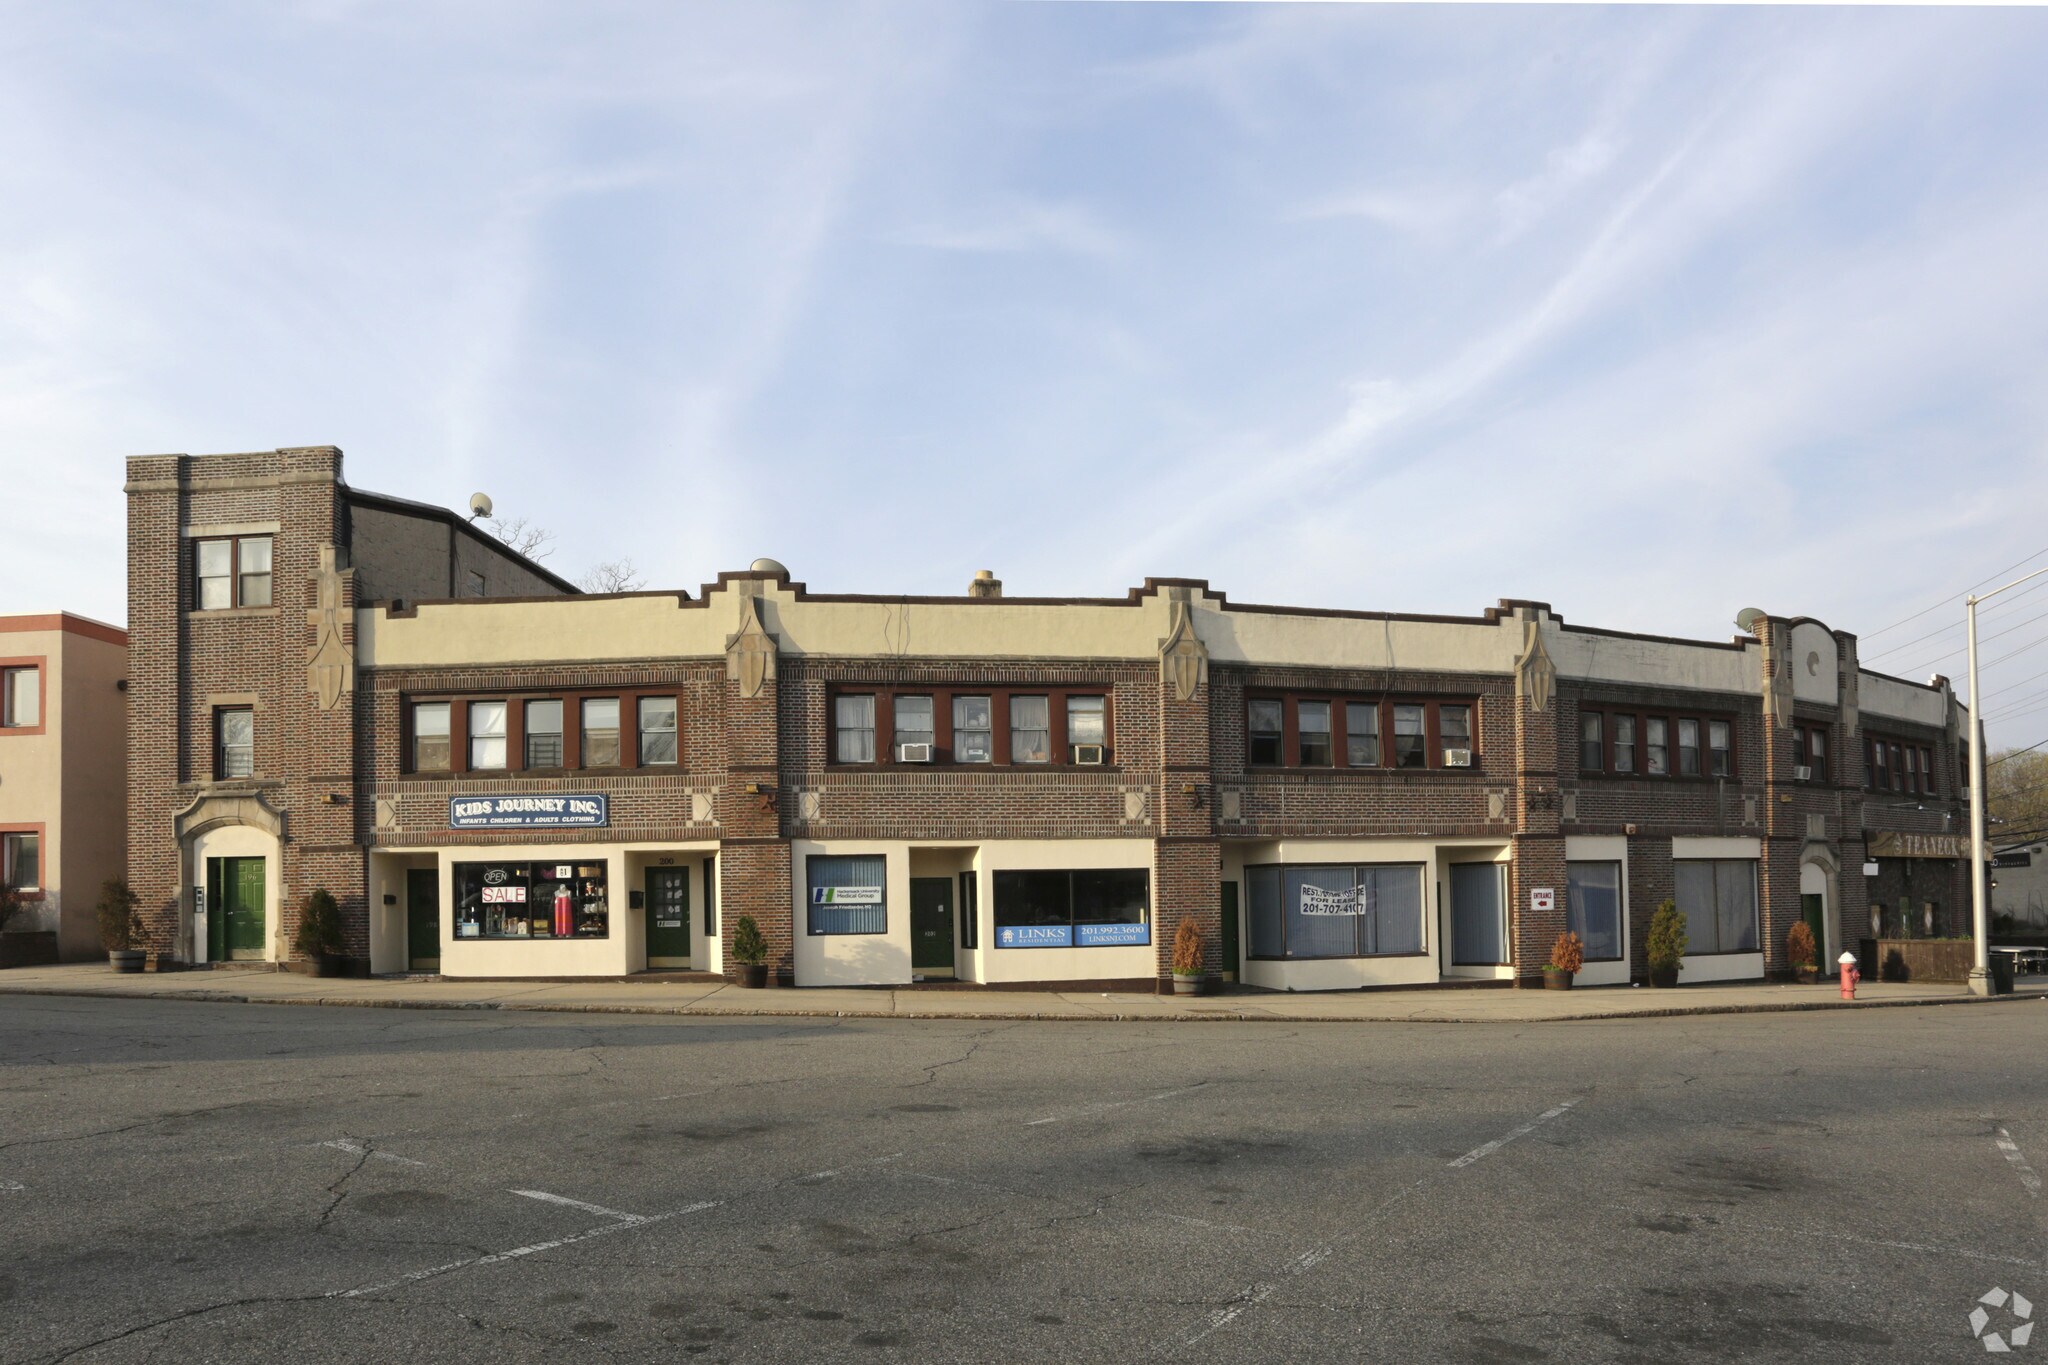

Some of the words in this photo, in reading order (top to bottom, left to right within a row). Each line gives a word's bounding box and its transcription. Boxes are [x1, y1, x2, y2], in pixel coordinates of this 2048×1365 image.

[455, 801, 492, 817] KIDS
[495, 798, 566, 813] JOURNEY
[569, 800, 601, 815] INC.
[1905, 835, 1959, 856] TEANECK
[659, 857, 674, 865] 200
[484, 872, 507, 881] OPEN
[482, 887, 525, 903] SALE
[1019, 928, 1066, 938] LINKS
[1081, 926, 1144, 935] 201.992.3600
